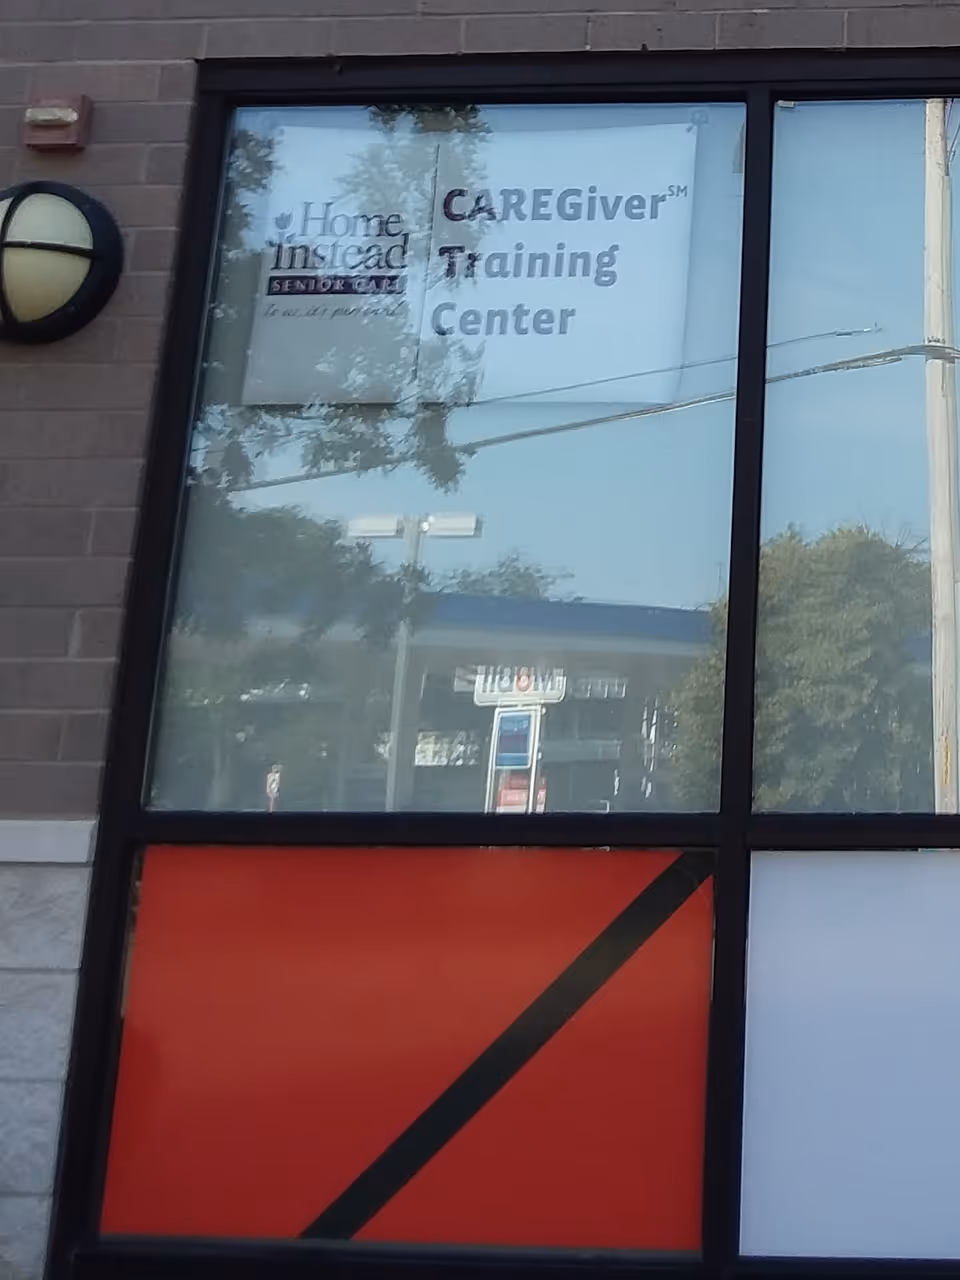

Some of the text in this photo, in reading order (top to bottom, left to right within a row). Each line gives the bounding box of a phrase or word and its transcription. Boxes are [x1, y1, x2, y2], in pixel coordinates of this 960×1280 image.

[300, 201, 405, 238] Home
[270, 232, 409, 271] Instead
[438, 242, 619, 287] Training
[272, 278, 345, 292] SENIOR
[431, 301, 576, 336] Center
